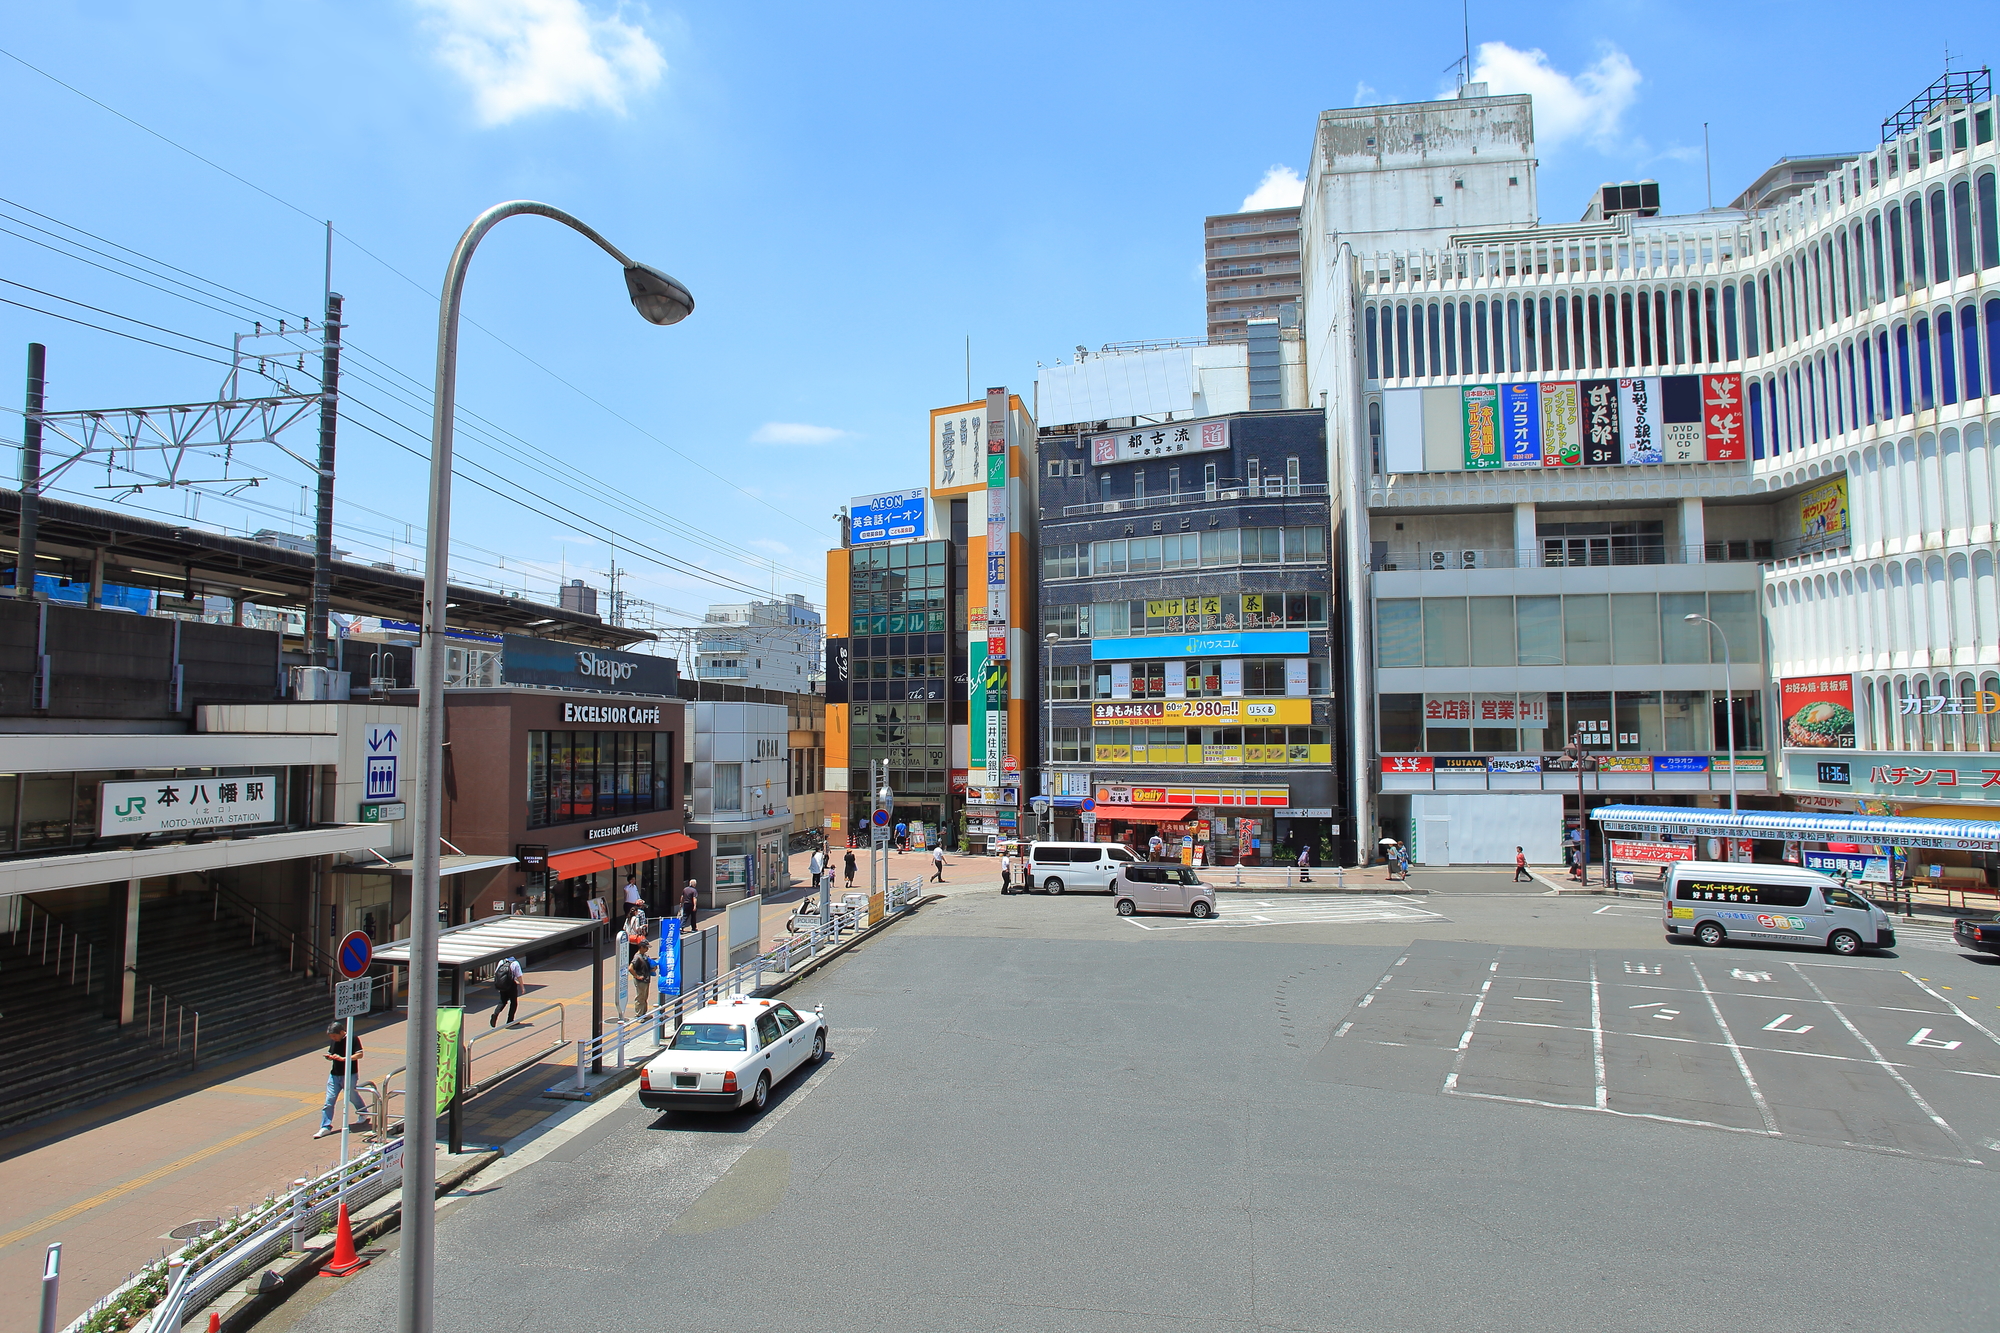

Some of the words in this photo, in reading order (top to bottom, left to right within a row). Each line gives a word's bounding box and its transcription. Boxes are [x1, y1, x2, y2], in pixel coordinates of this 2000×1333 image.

[1566, 388, 1576, 425] コミック
[1588, 385, 1612, 445] 甘太郎
[1556, 391, 1566, 448] インターネット
[1632, 380, 1652, 452] 目利きの銀次
[1204, 424, 1223, 446] 道
[1469, 403, 1481, 458] ゴルフクラブ
[1481, 408, 1494, 454] 本八幡駅前
[1513, 401, 1530, 453] カラオケ
[1544, 398, 1554, 454] フリードリンク
[1128, 428, 1190, 448] 都古流
[1096, 441, 1114, 460] 花
[1592, 450, 1612, 461] 3F
[1720, 450, 1732, 458] 2F
[1478, 459, 1489, 467] 5F
[912, 490, 922, 498] 3F
[871, 495, 903, 512] AEON
[1803, 496, 1837, 519] ボウリング
[853, 510, 922, 528] 英会話イーオン
[1124, 515, 1219, 534] 内田ビル
[996, 524, 1004, 550] ダンス
[1150, 599, 1218, 614] いけばな
[1246, 597, 1260, 612] 茶
[855, 615, 924, 633] エイブル
[1168, 612, 1282, 632] 新会員募集中
[1199, 638, 1238, 649] ハウスコム
[580, 651, 638, 685] Shapo
[908, 686, 925, 699] The
[1132, 676, 1220, 691] 地域1番
[1785, 680, 1848, 693] お好み焼・鉄板焼
[565, 702, 626, 723] EXCELSIOR
[629, 706, 660, 724] CAFFÉ
[854, 706, 868, 716] 2F
[1096, 704, 1162, 717] 全身もみほぐし
[1426, 700, 1474, 720] 全店舗
[1902, 694, 1962, 714] カフェ
[757, 740, 778, 757] KOBAN
[988, 716, 997, 782] 三井住友銀行
[1842, 738, 1854, 746] 2F
[1492, 760, 1535, 769] 目利きの銀次
[1870, 764, 1958, 786] パチンコ
[158, 782, 264, 807] 本八幡駅
[1134, 789, 1162, 802] Daily
[1814, 797, 1842, 807] スロット
[115, 796, 146, 816] JR
[161, 816, 224, 828] MOTO-YAWATA
[228, 813, 260, 822] STATION
[589, 826, 620, 839] EXCELSIOR
[621, 822, 639, 834] CAFFÉ
[1605, 822, 1658, 832] 市川総合病院経由
[1696, 827, 1775, 838] 昭和学院・高塚入口経由
[1846, 834, 1909, 845] 市川大野駅経由
[1957, 840, 1993, 850] のりば
[1634, 850, 1688, 860] アーバンホーム
[1808, 857, 1863, 870] 津田眼科
[1692, 883, 1758, 893] ペーパードライバー
[1692, 891, 1758, 903] 好評受付中!
